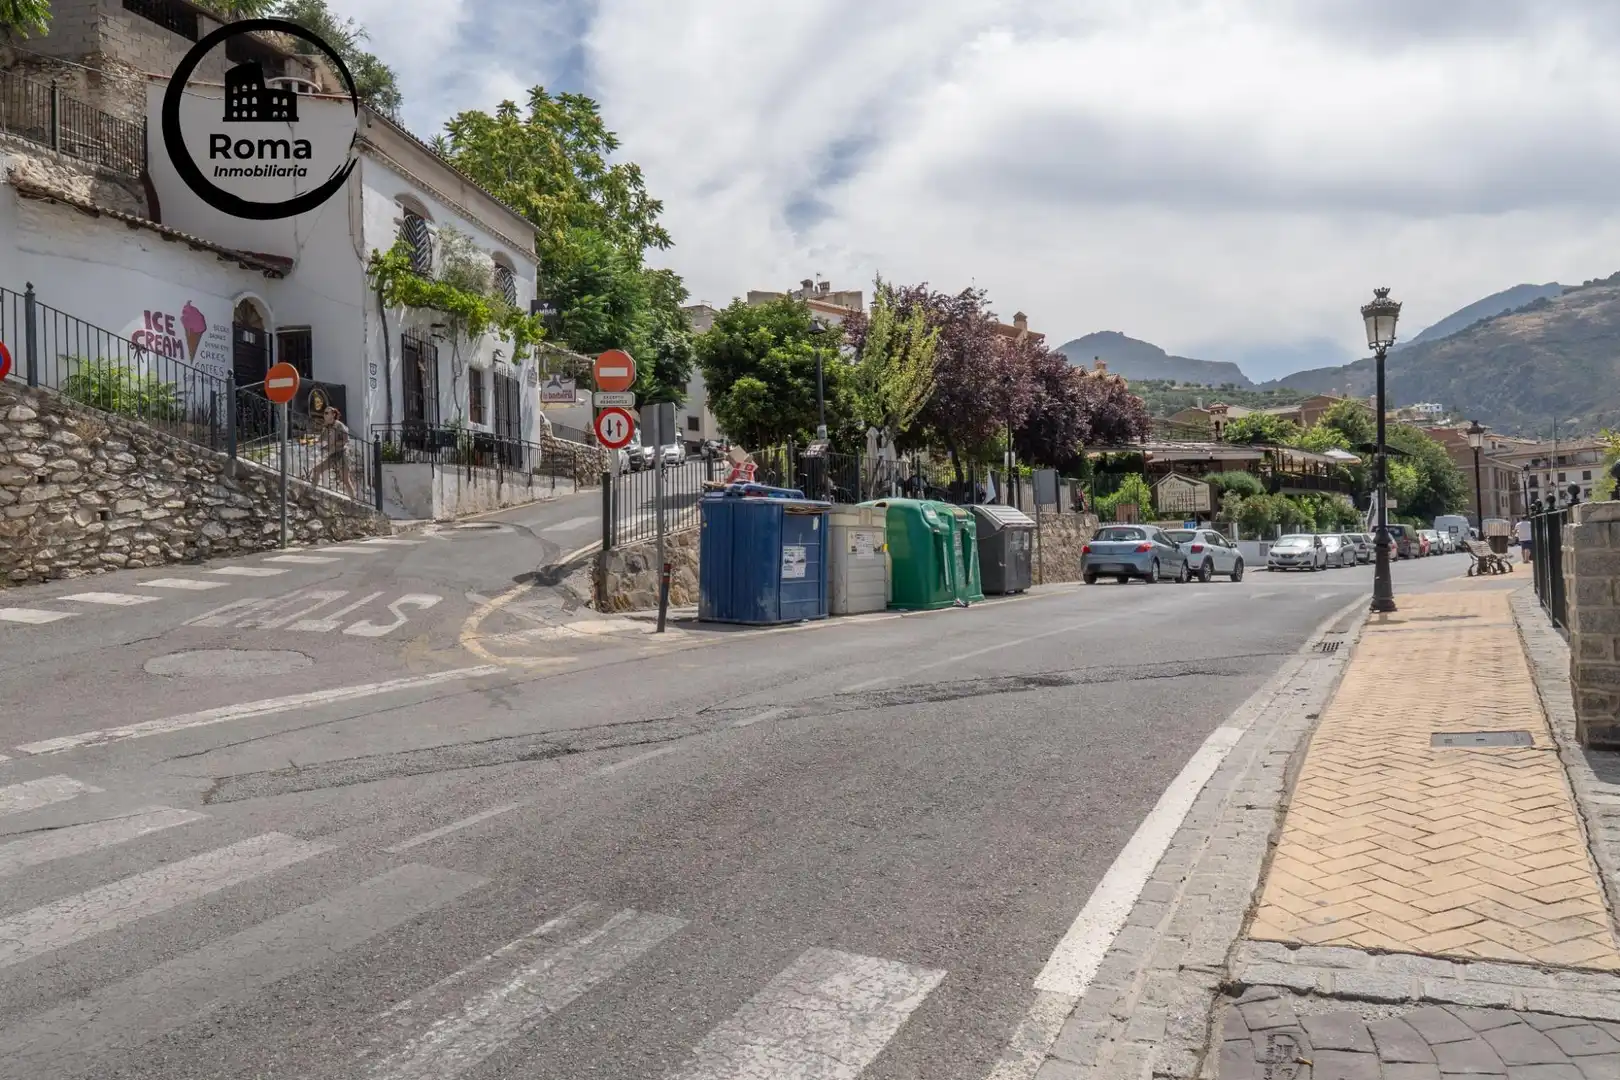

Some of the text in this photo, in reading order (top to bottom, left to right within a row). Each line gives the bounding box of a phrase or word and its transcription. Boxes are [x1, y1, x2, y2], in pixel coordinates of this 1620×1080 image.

[143, 309, 176, 337] ICE
[131, 329, 185, 360] CREAM
[200, 350, 226, 363] CAKES
